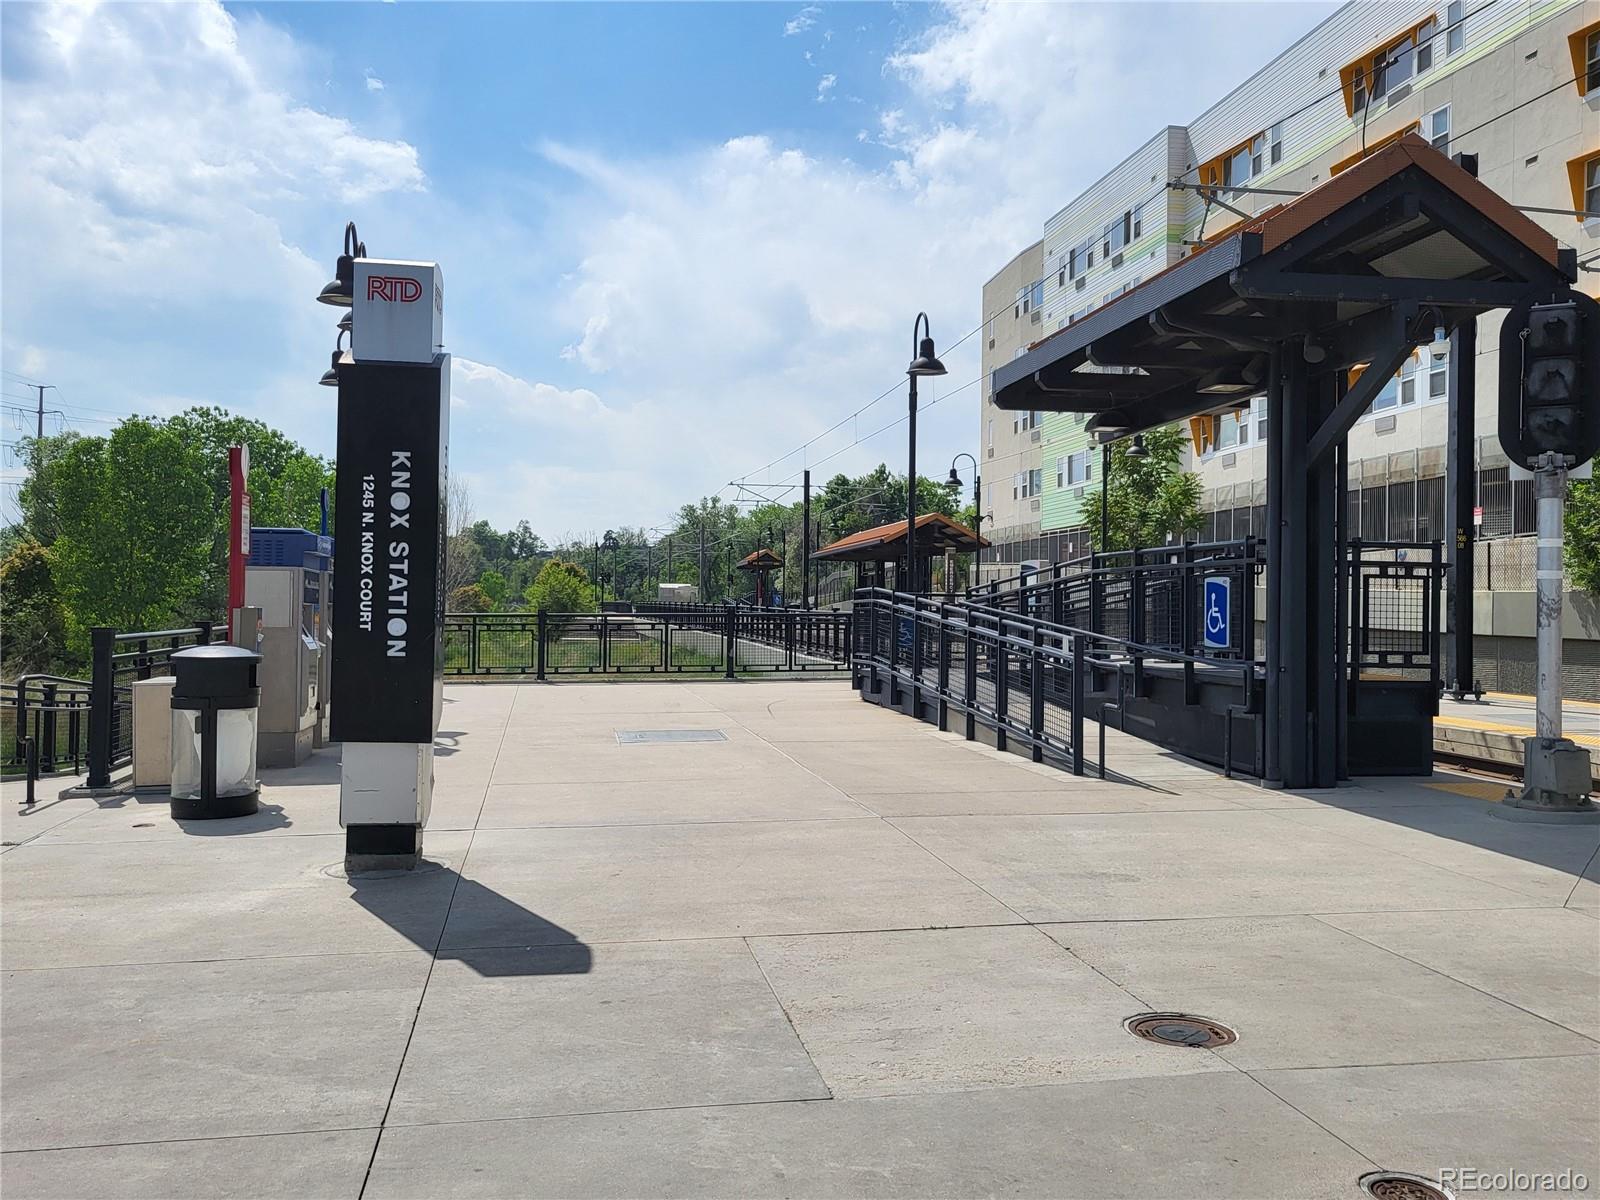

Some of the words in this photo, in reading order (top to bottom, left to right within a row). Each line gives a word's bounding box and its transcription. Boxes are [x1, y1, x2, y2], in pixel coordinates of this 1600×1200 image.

[368, 276, 423, 303] RTD
[362, 474, 374, 508] 1245
[390, 451, 411, 528] KNOX
[361, 512, 374, 527] N.
[360, 532, 374, 575] KNOX
[359, 578, 373, 632] COURT
[387, 541, 409, 656] STATION
